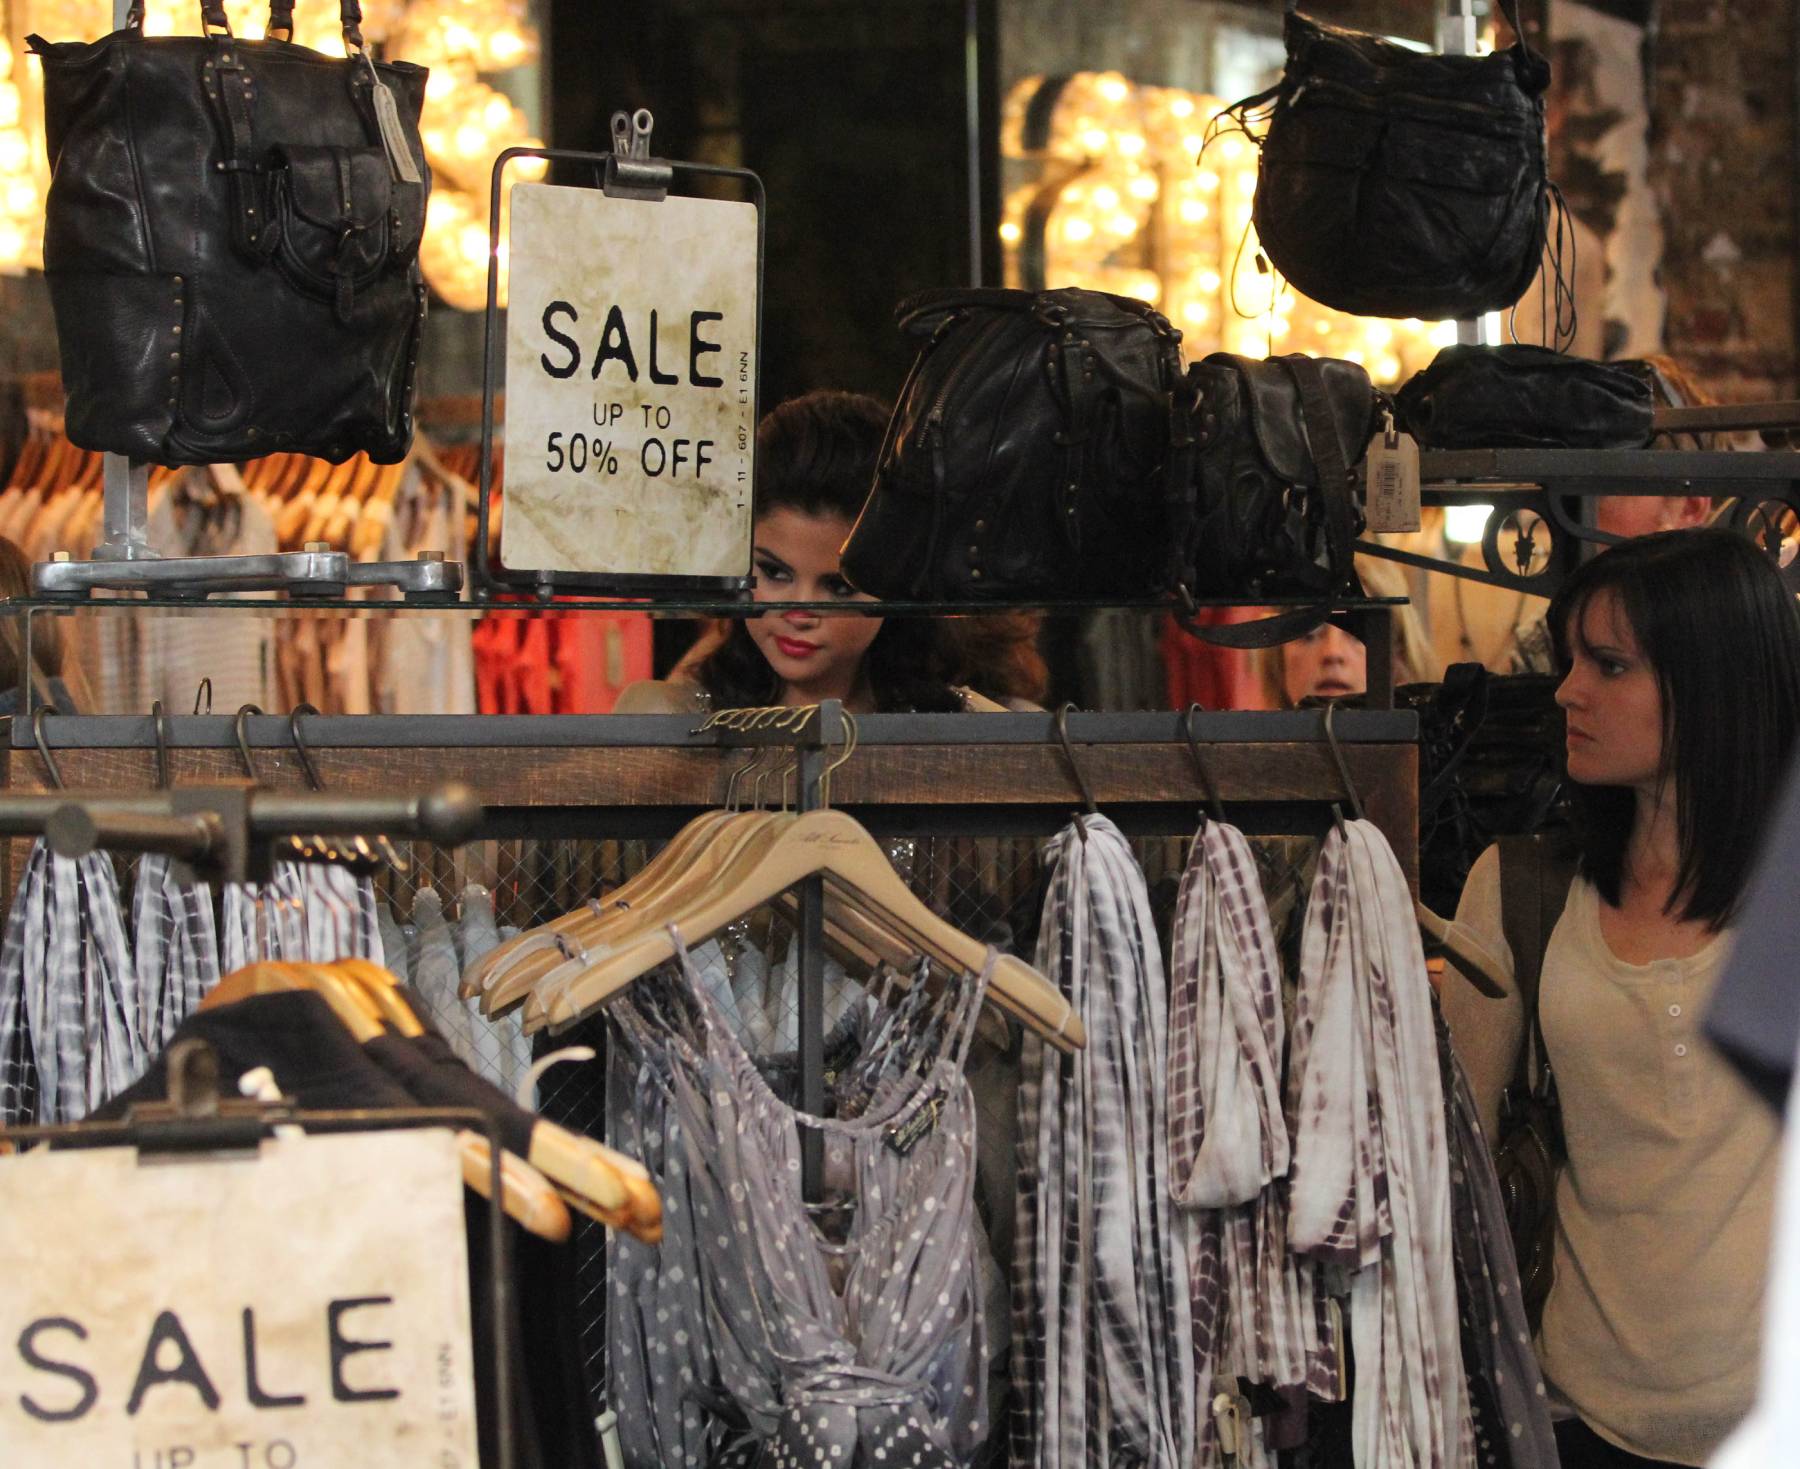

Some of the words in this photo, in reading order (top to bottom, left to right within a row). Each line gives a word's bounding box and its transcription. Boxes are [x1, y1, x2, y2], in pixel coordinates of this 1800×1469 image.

[540, 300, 724, 389] SALE
[739, 352, 748, 382] 6NN
[739, 389, 748, 404] E1
[593, 402, 624, 427] UP
[640, 404, 671, 430] TO
[738, 425, 747, 450] 607
[546, 431, 618, 475] 50%
[640, 437, 715, 479] OFF
[737, 472, 747, 482] 11
[17, 1295, 401, 1422] SALE
[134, 1446, 195, 1469] UP
[235, 1440, 297, 1469] TO
